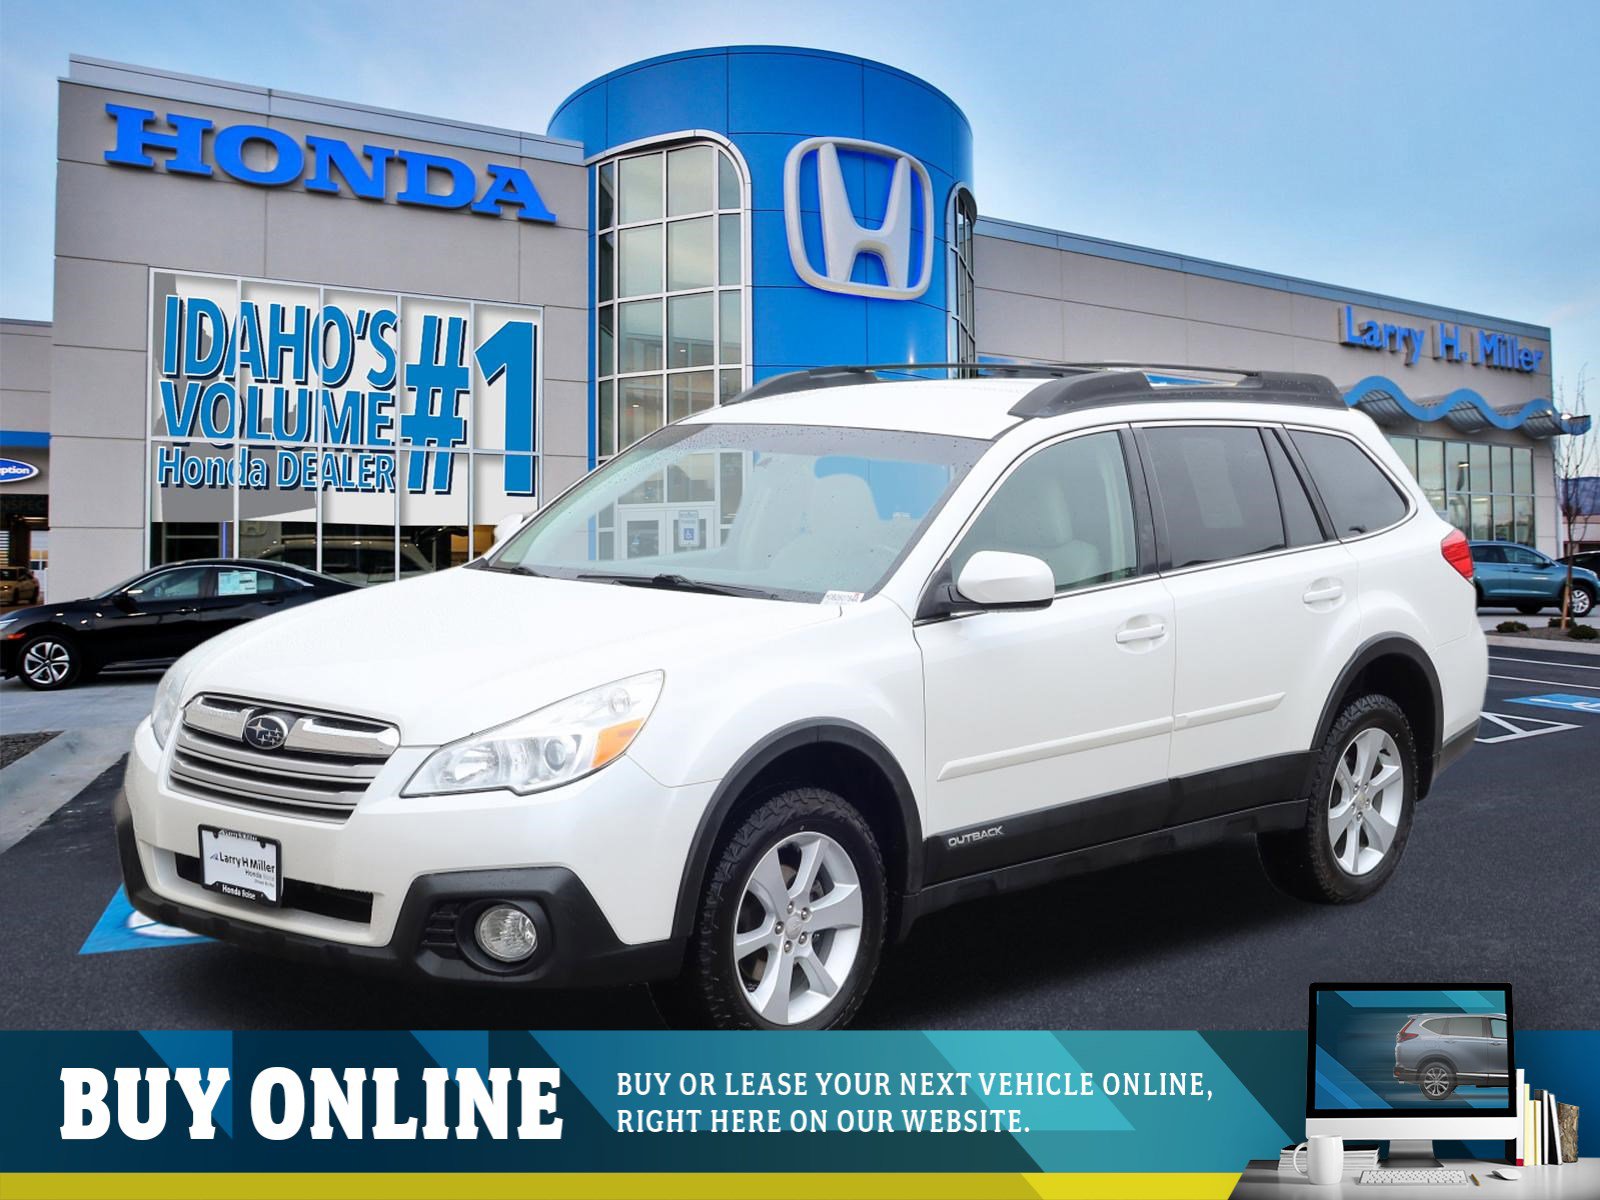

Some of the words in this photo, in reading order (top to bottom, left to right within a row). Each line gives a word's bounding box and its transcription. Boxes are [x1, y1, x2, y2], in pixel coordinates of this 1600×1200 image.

[104, 103, 557, 223] HONDA
[162, 294, 399, 389] IDAHO'S
[1344, 305, 1425, 366] Larry
[1437, 322, 1468, 361] H.
[1477, 330, 1544, 372] Miller
[159, 380, 395, 451] VOLUME
[400, 313, 537, 498] #1
[0, 465, 30, 476] ption
[157, 446, 267, 489] Honda
[276, 450, 396, 494] DEALER
[220, 852, 241, 868] Larry
[242, 856, 249, 867] H
[250, 858, 275, 873] Miller
[948, 825, 1004, 847] OUTBACK
[222, 885, 241, 896] Honda
